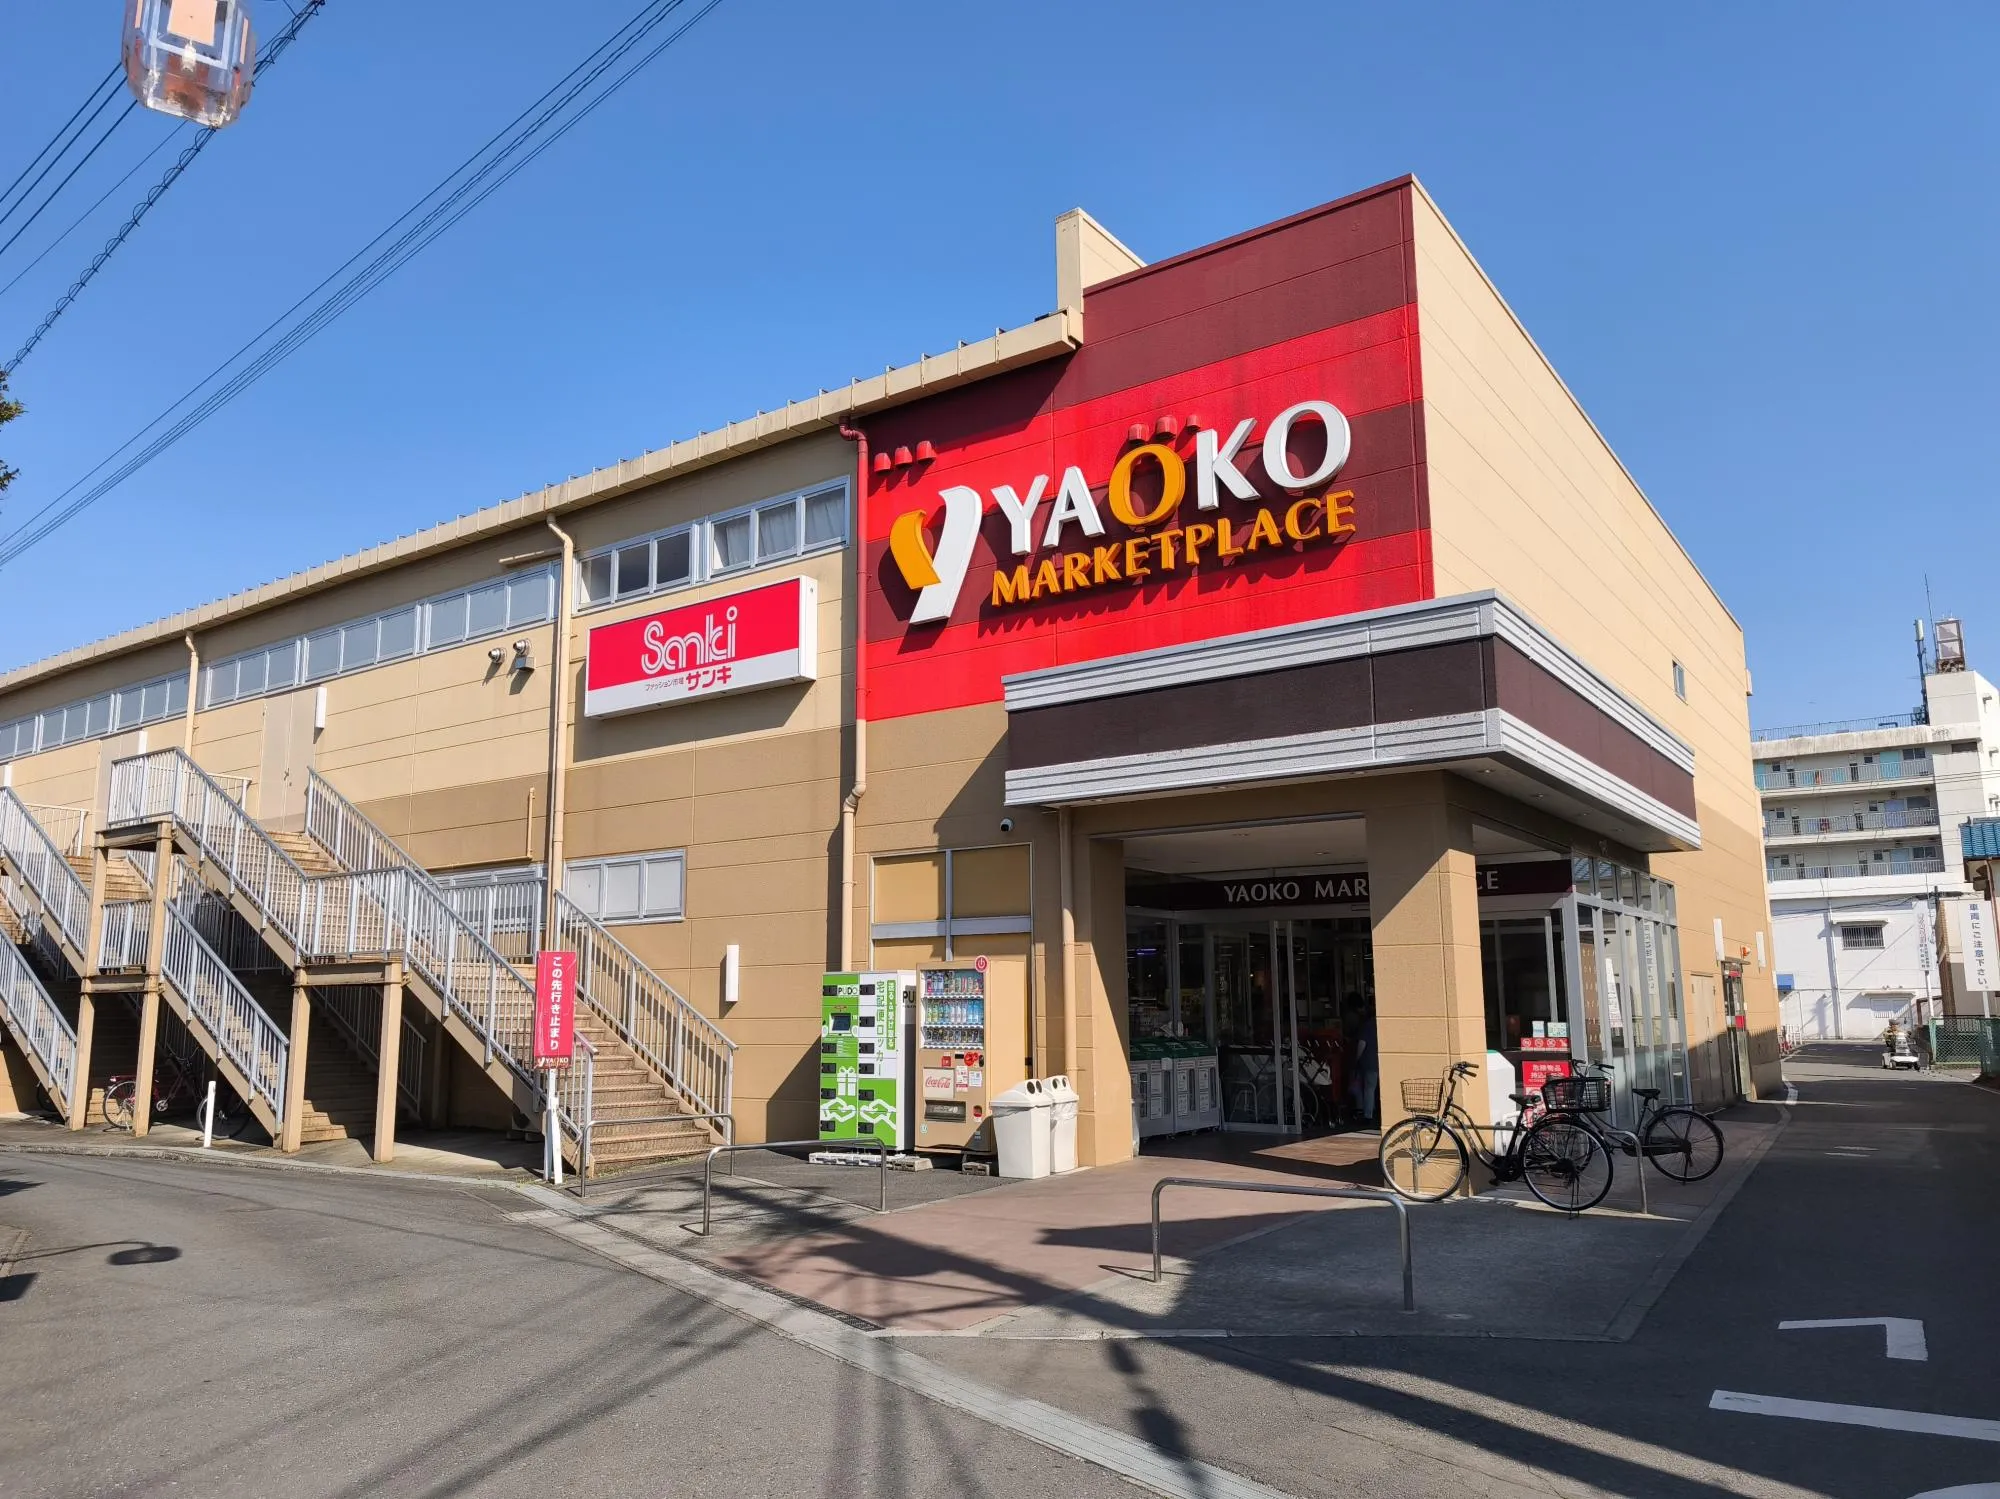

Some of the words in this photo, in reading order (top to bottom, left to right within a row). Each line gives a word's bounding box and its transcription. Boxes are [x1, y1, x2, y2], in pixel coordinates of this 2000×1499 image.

[991, 401, 1351, 555] YAOKO
[991, 490, 1356, 606] MARKETPLACE
[641, 606, 738, 674] Sanki
[686, 666, 732, 690] サンキ
[1225, 881, 1300, 902] YAOKO
[549, 956, 563, 1051] この先行き止まり
[838, 987, 858, 995] PUDO
[902, 990, 916, 1004] PU
